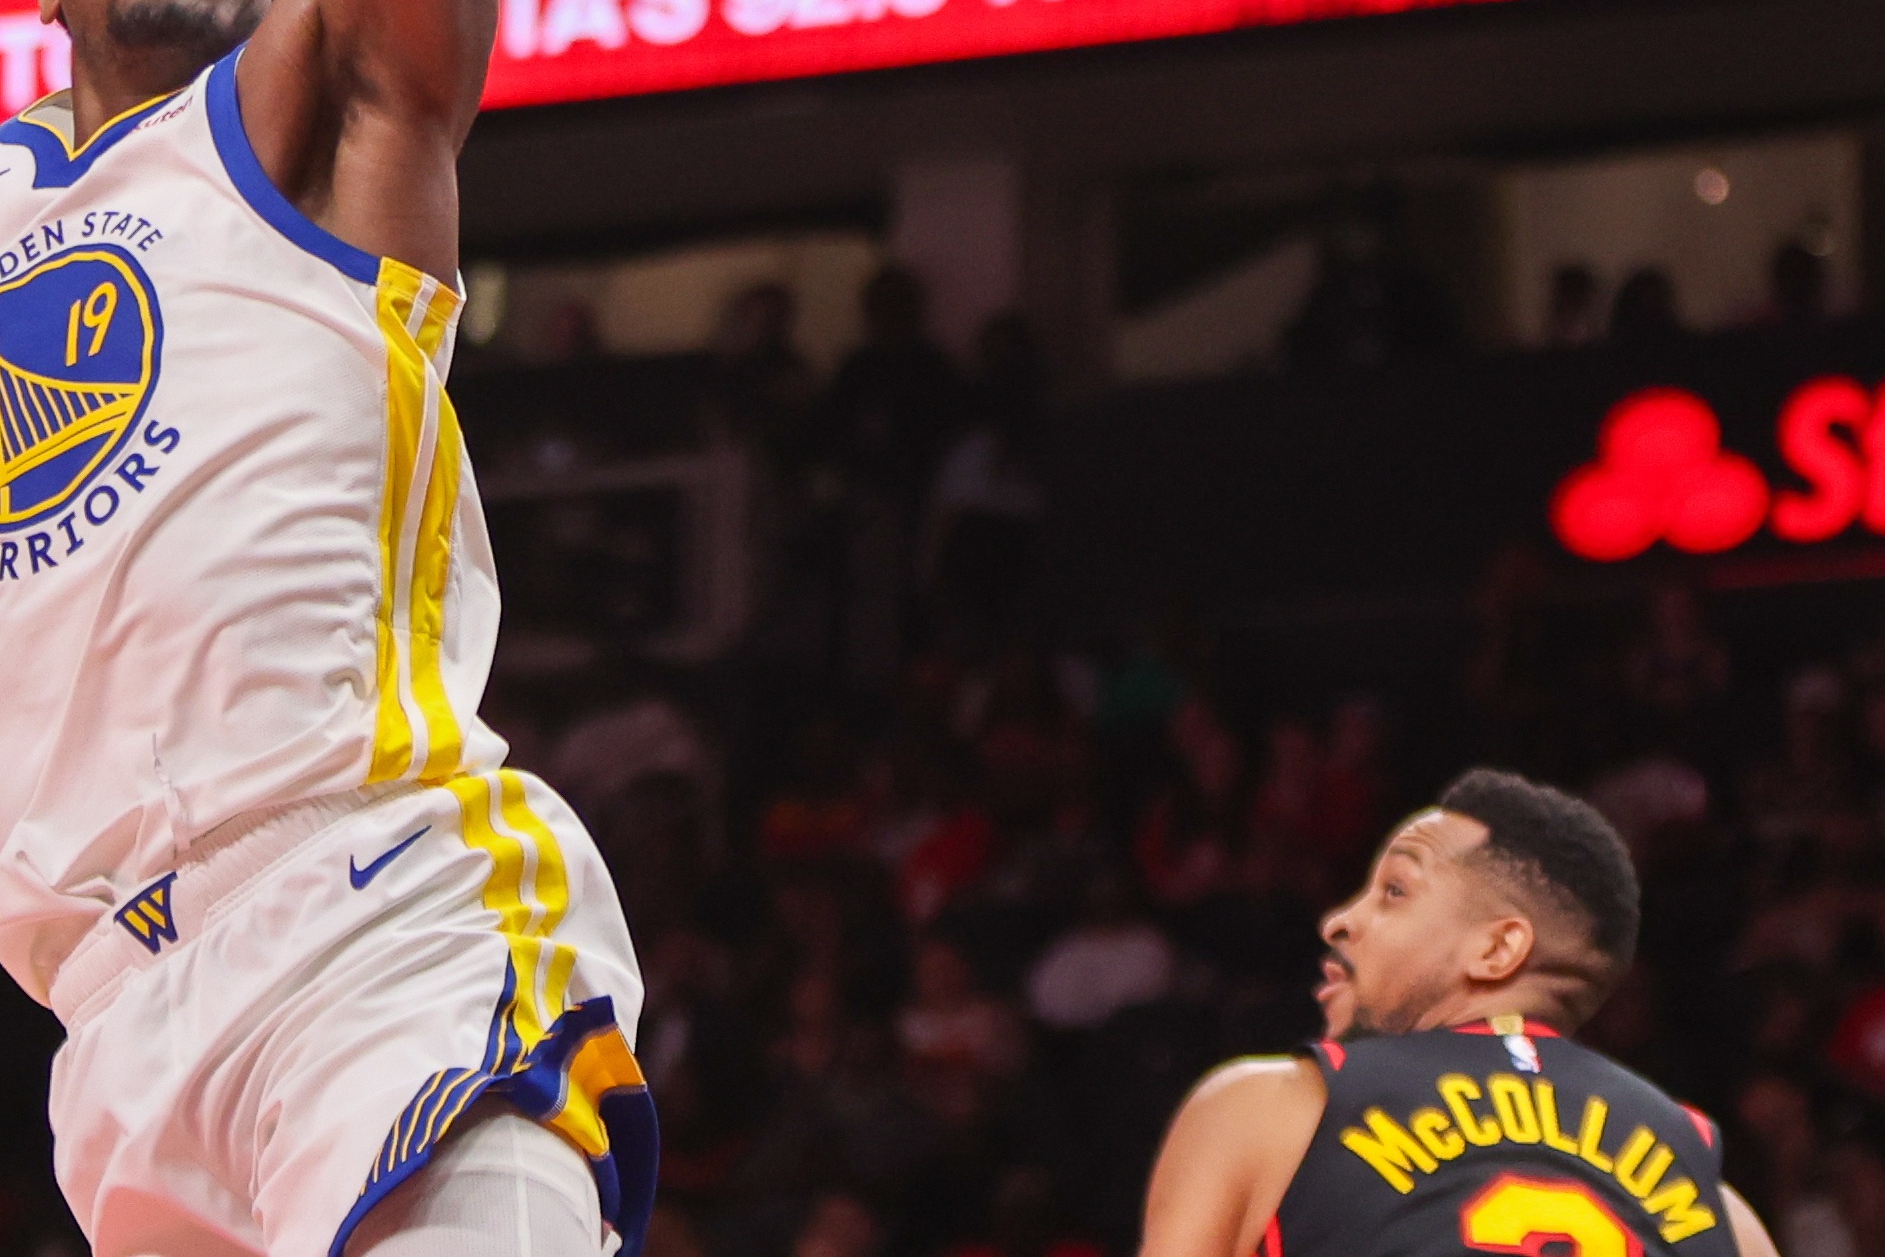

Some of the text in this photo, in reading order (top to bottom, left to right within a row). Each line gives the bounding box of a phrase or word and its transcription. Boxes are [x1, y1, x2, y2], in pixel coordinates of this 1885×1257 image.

[82, 211, 164, 253] STATE
[65, 281, 118, 367] 19
[1341, 1072, 1716, 1244] McCOLLUM
